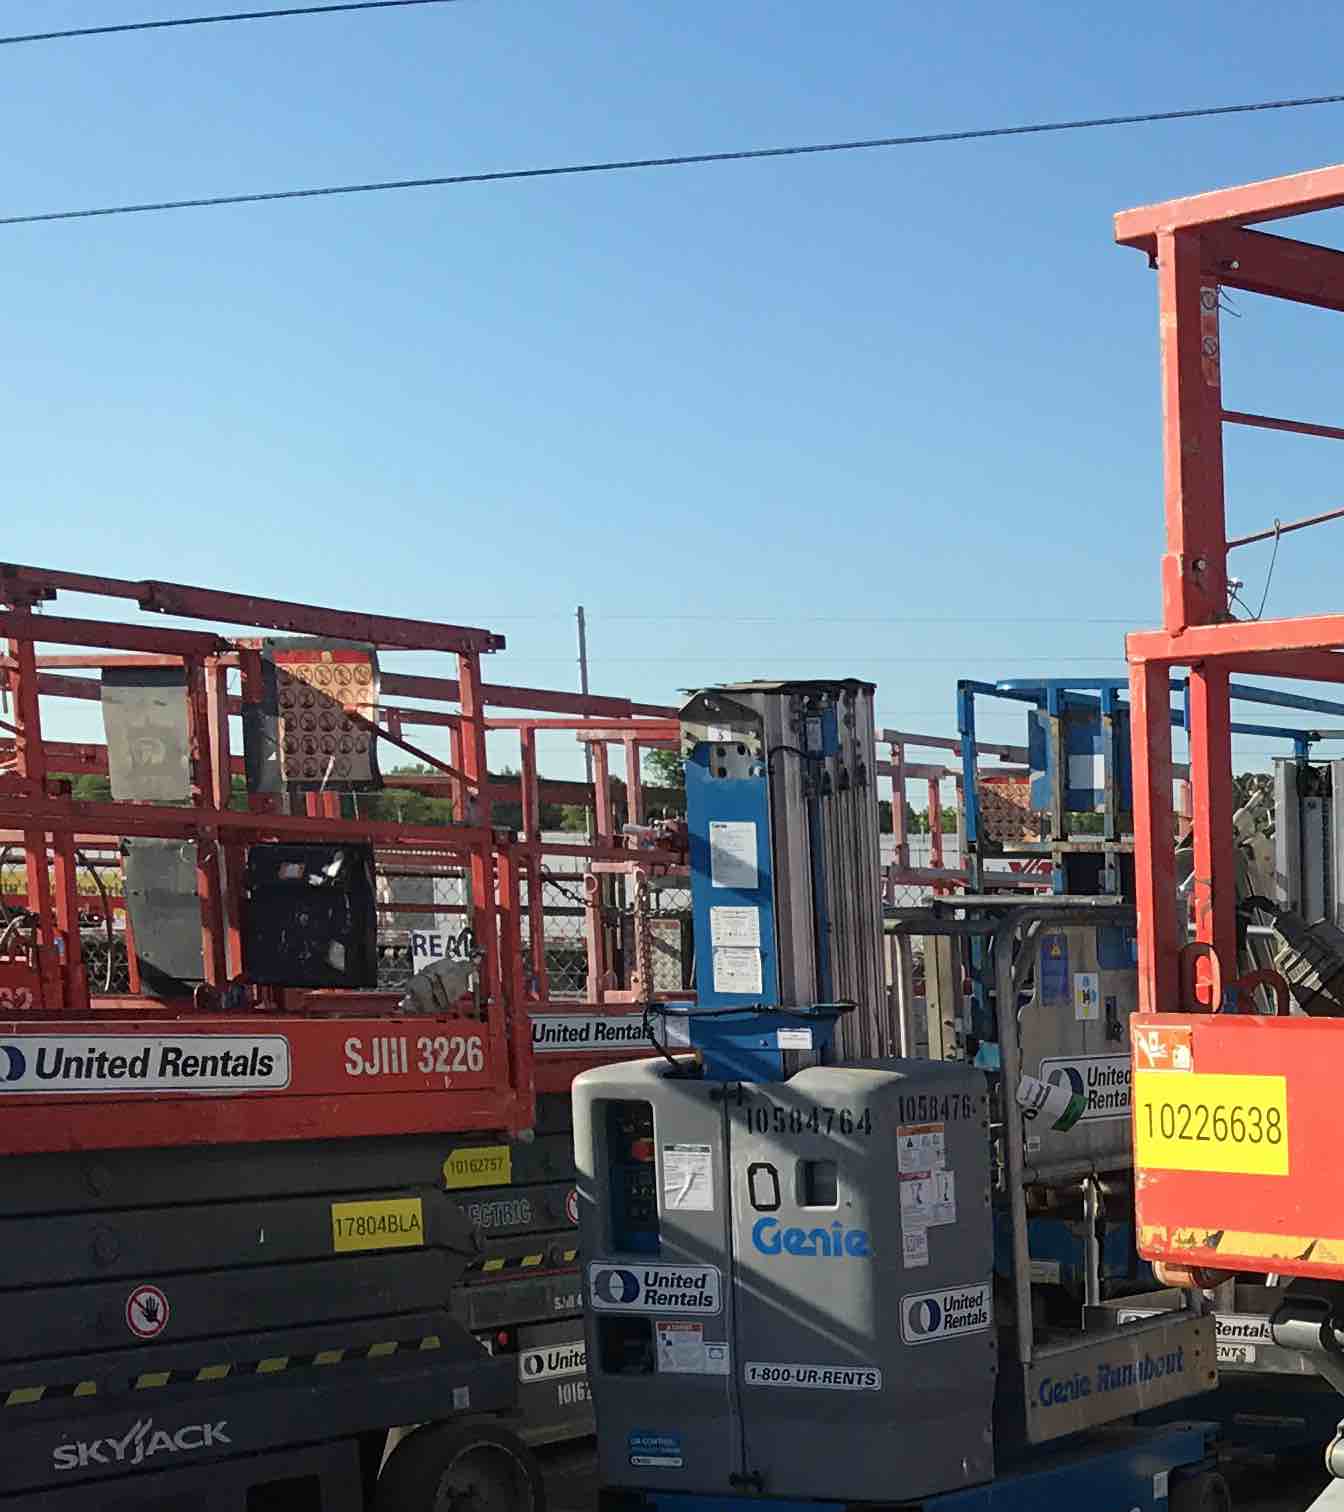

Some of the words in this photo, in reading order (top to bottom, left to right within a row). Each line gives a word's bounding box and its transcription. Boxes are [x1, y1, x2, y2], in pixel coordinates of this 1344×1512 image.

[531, 1022, 591, 1043] United
[35, 1046, 150, 1080] United
[157, 1046, 274, 1079] Rentals
[344, 1037, 408, 1076] SJIII
[417, 1035, 484, 1074] 3226
[746, 1106, 873, 1136] 10584764
[898, 1093, 977, 1122] 1058476
[1143, 1103, 1283, 1145] 10226638
[334, 1213, 421, 1238] 17804BLA
[466, 1199, 533, 1229] ECTRIC
[751, 1216, 873, 1257] Genie
[643, 1271, 708, 1290] United
[643, 1289, 714, 1308] Rentals
[942, 1290, 984, 1314] United
[942, 1307, 988, 1331] Rentals
[749, 1366, 877, 1387] 1-800-UR-RENTS
[1039, 1372, 1091, 1408] Genie
[52, 1416, 233, 1470] SKYJACK
